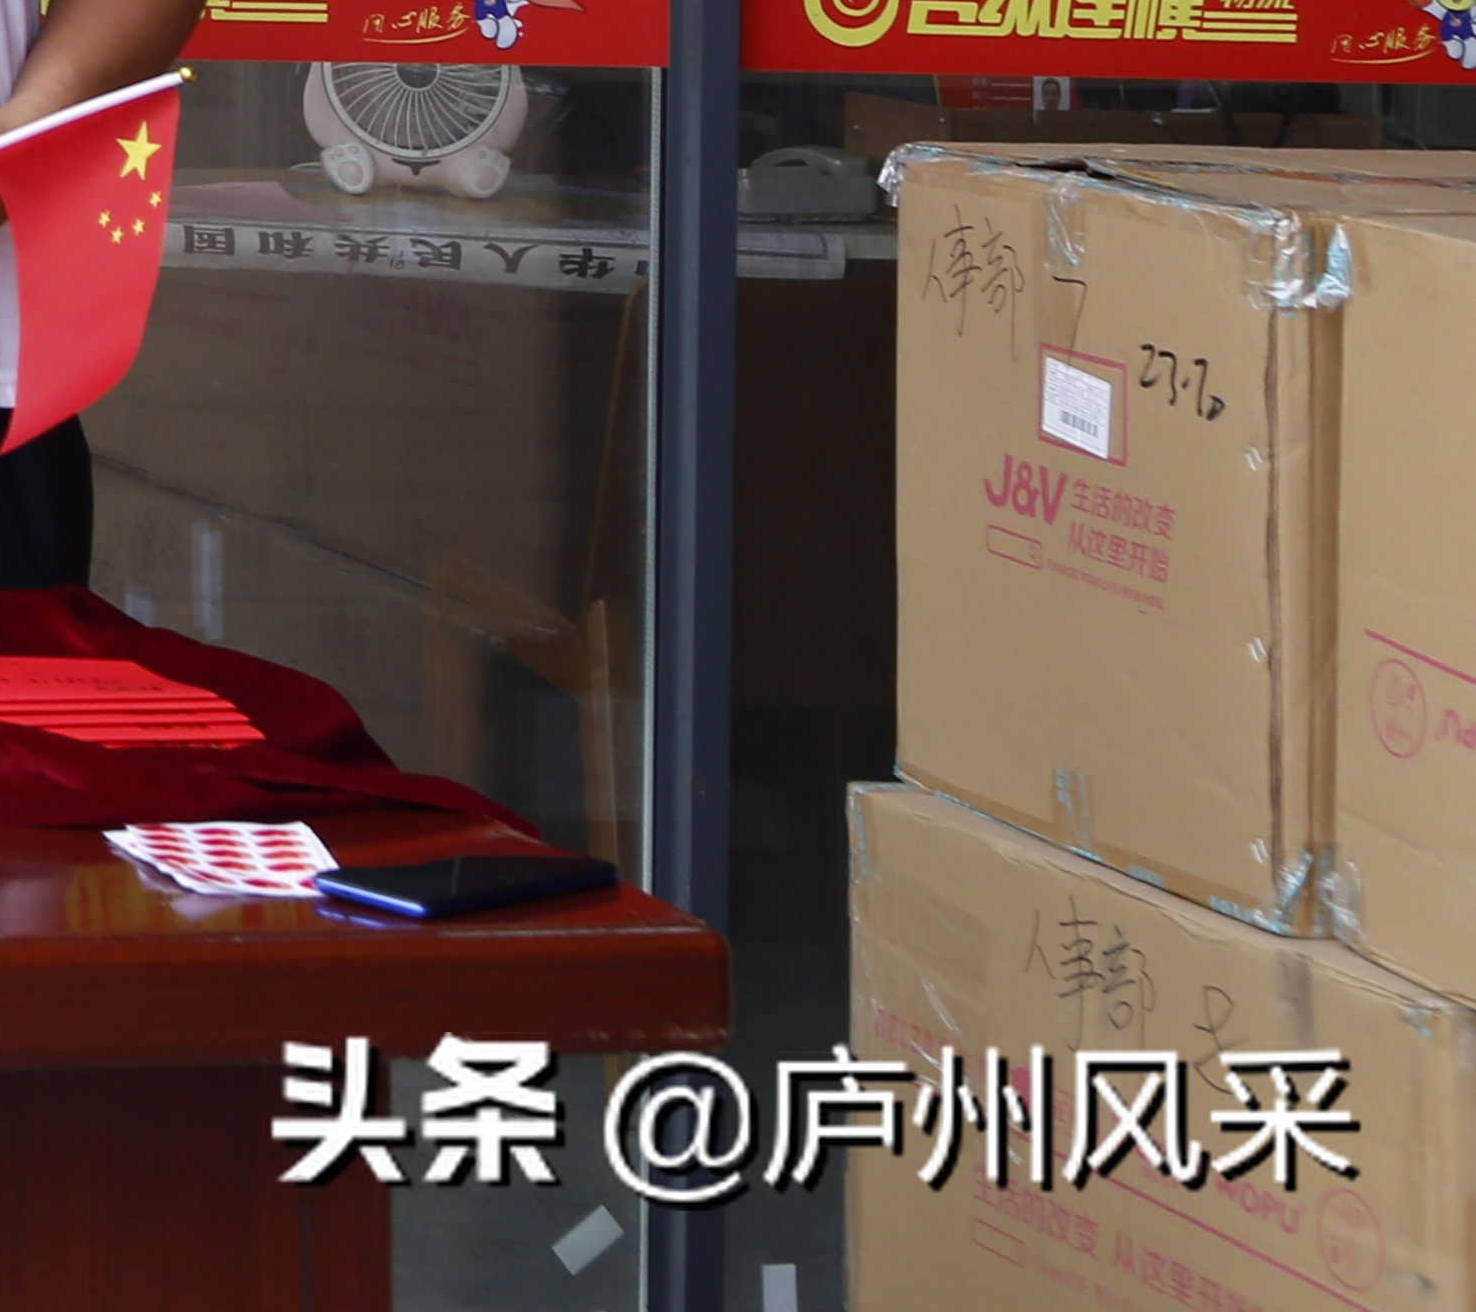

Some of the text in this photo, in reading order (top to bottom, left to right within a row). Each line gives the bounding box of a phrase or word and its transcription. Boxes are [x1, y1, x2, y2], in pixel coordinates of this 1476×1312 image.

[983, 453, 1069, 526] J&V
[1071, 477, 1177, 542] 生活的改变
